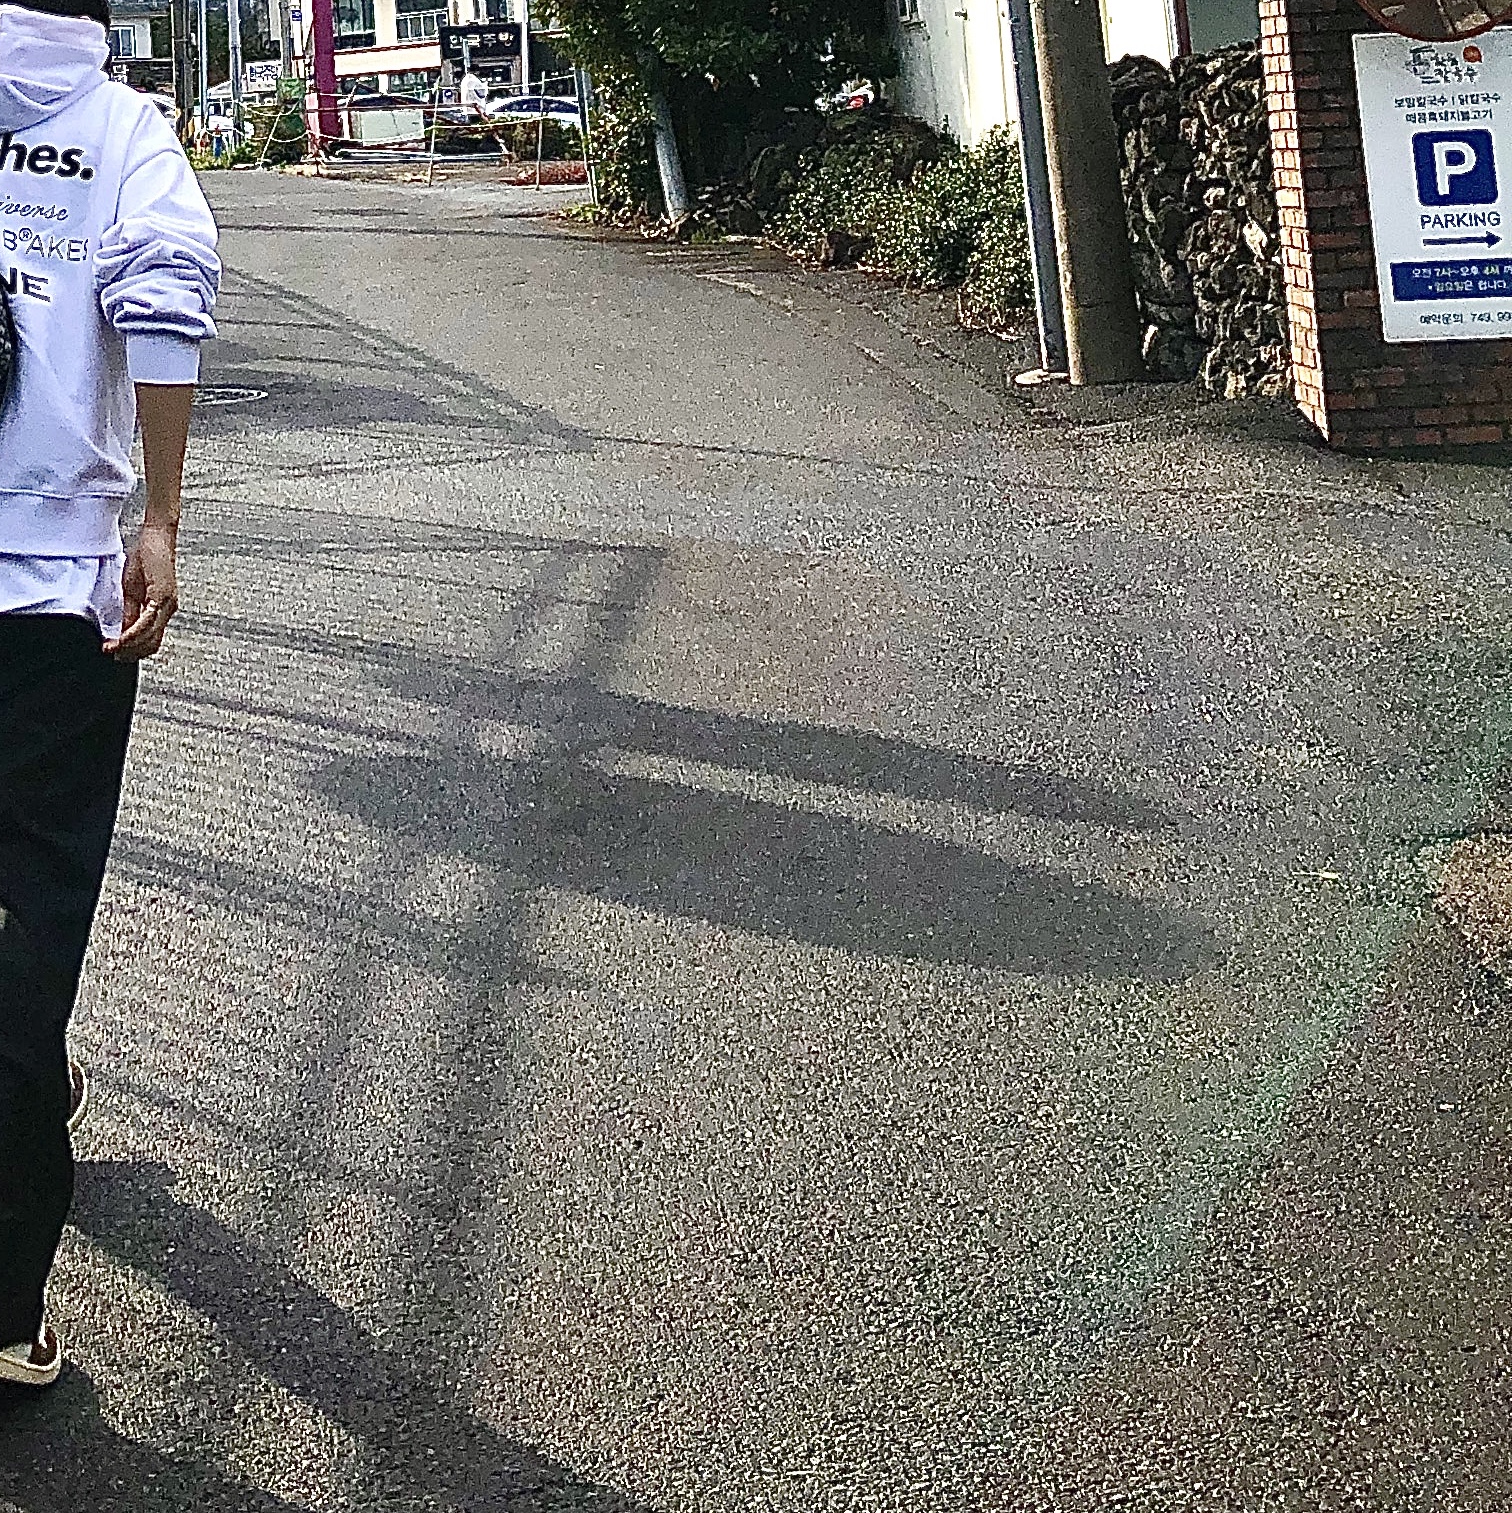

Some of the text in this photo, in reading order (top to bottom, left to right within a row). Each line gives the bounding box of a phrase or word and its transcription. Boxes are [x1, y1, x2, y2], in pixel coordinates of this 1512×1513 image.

[449, 32, 514, 48] 한국주방
[1433, 141, 1476, 196] P
[1420, 210, 1501, 230] PARKING
[1412, 267, 1432, 279] 오전
